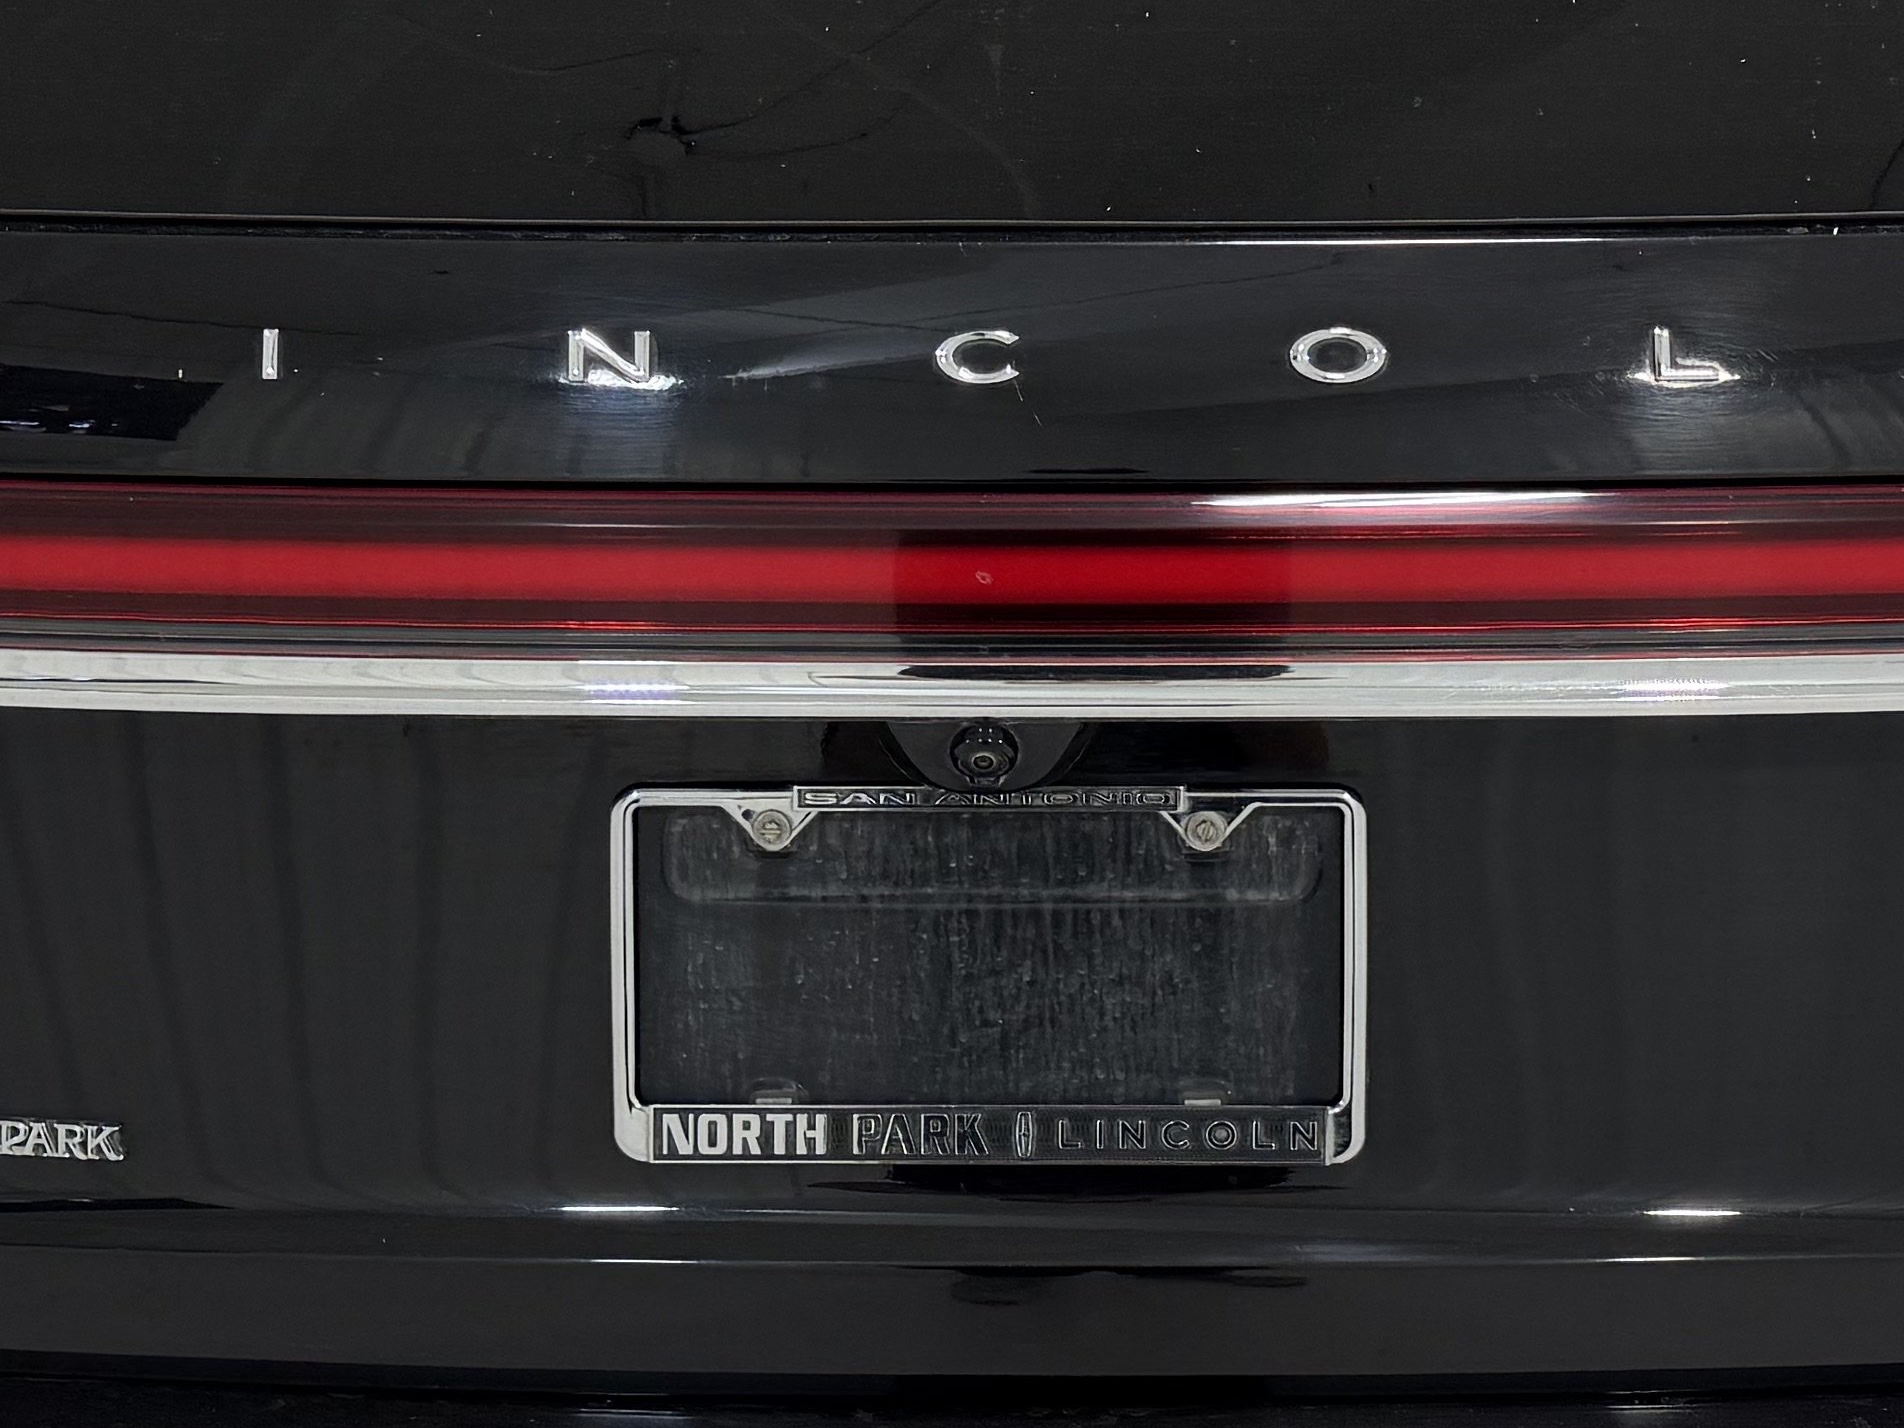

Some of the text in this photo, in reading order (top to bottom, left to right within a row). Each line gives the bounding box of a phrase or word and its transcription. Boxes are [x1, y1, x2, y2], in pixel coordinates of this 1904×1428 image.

[803, 791, 1172, 806] SAN ANTONIO
[661, 1113, 1318, 1155] NORTH PARK LINCOLN
